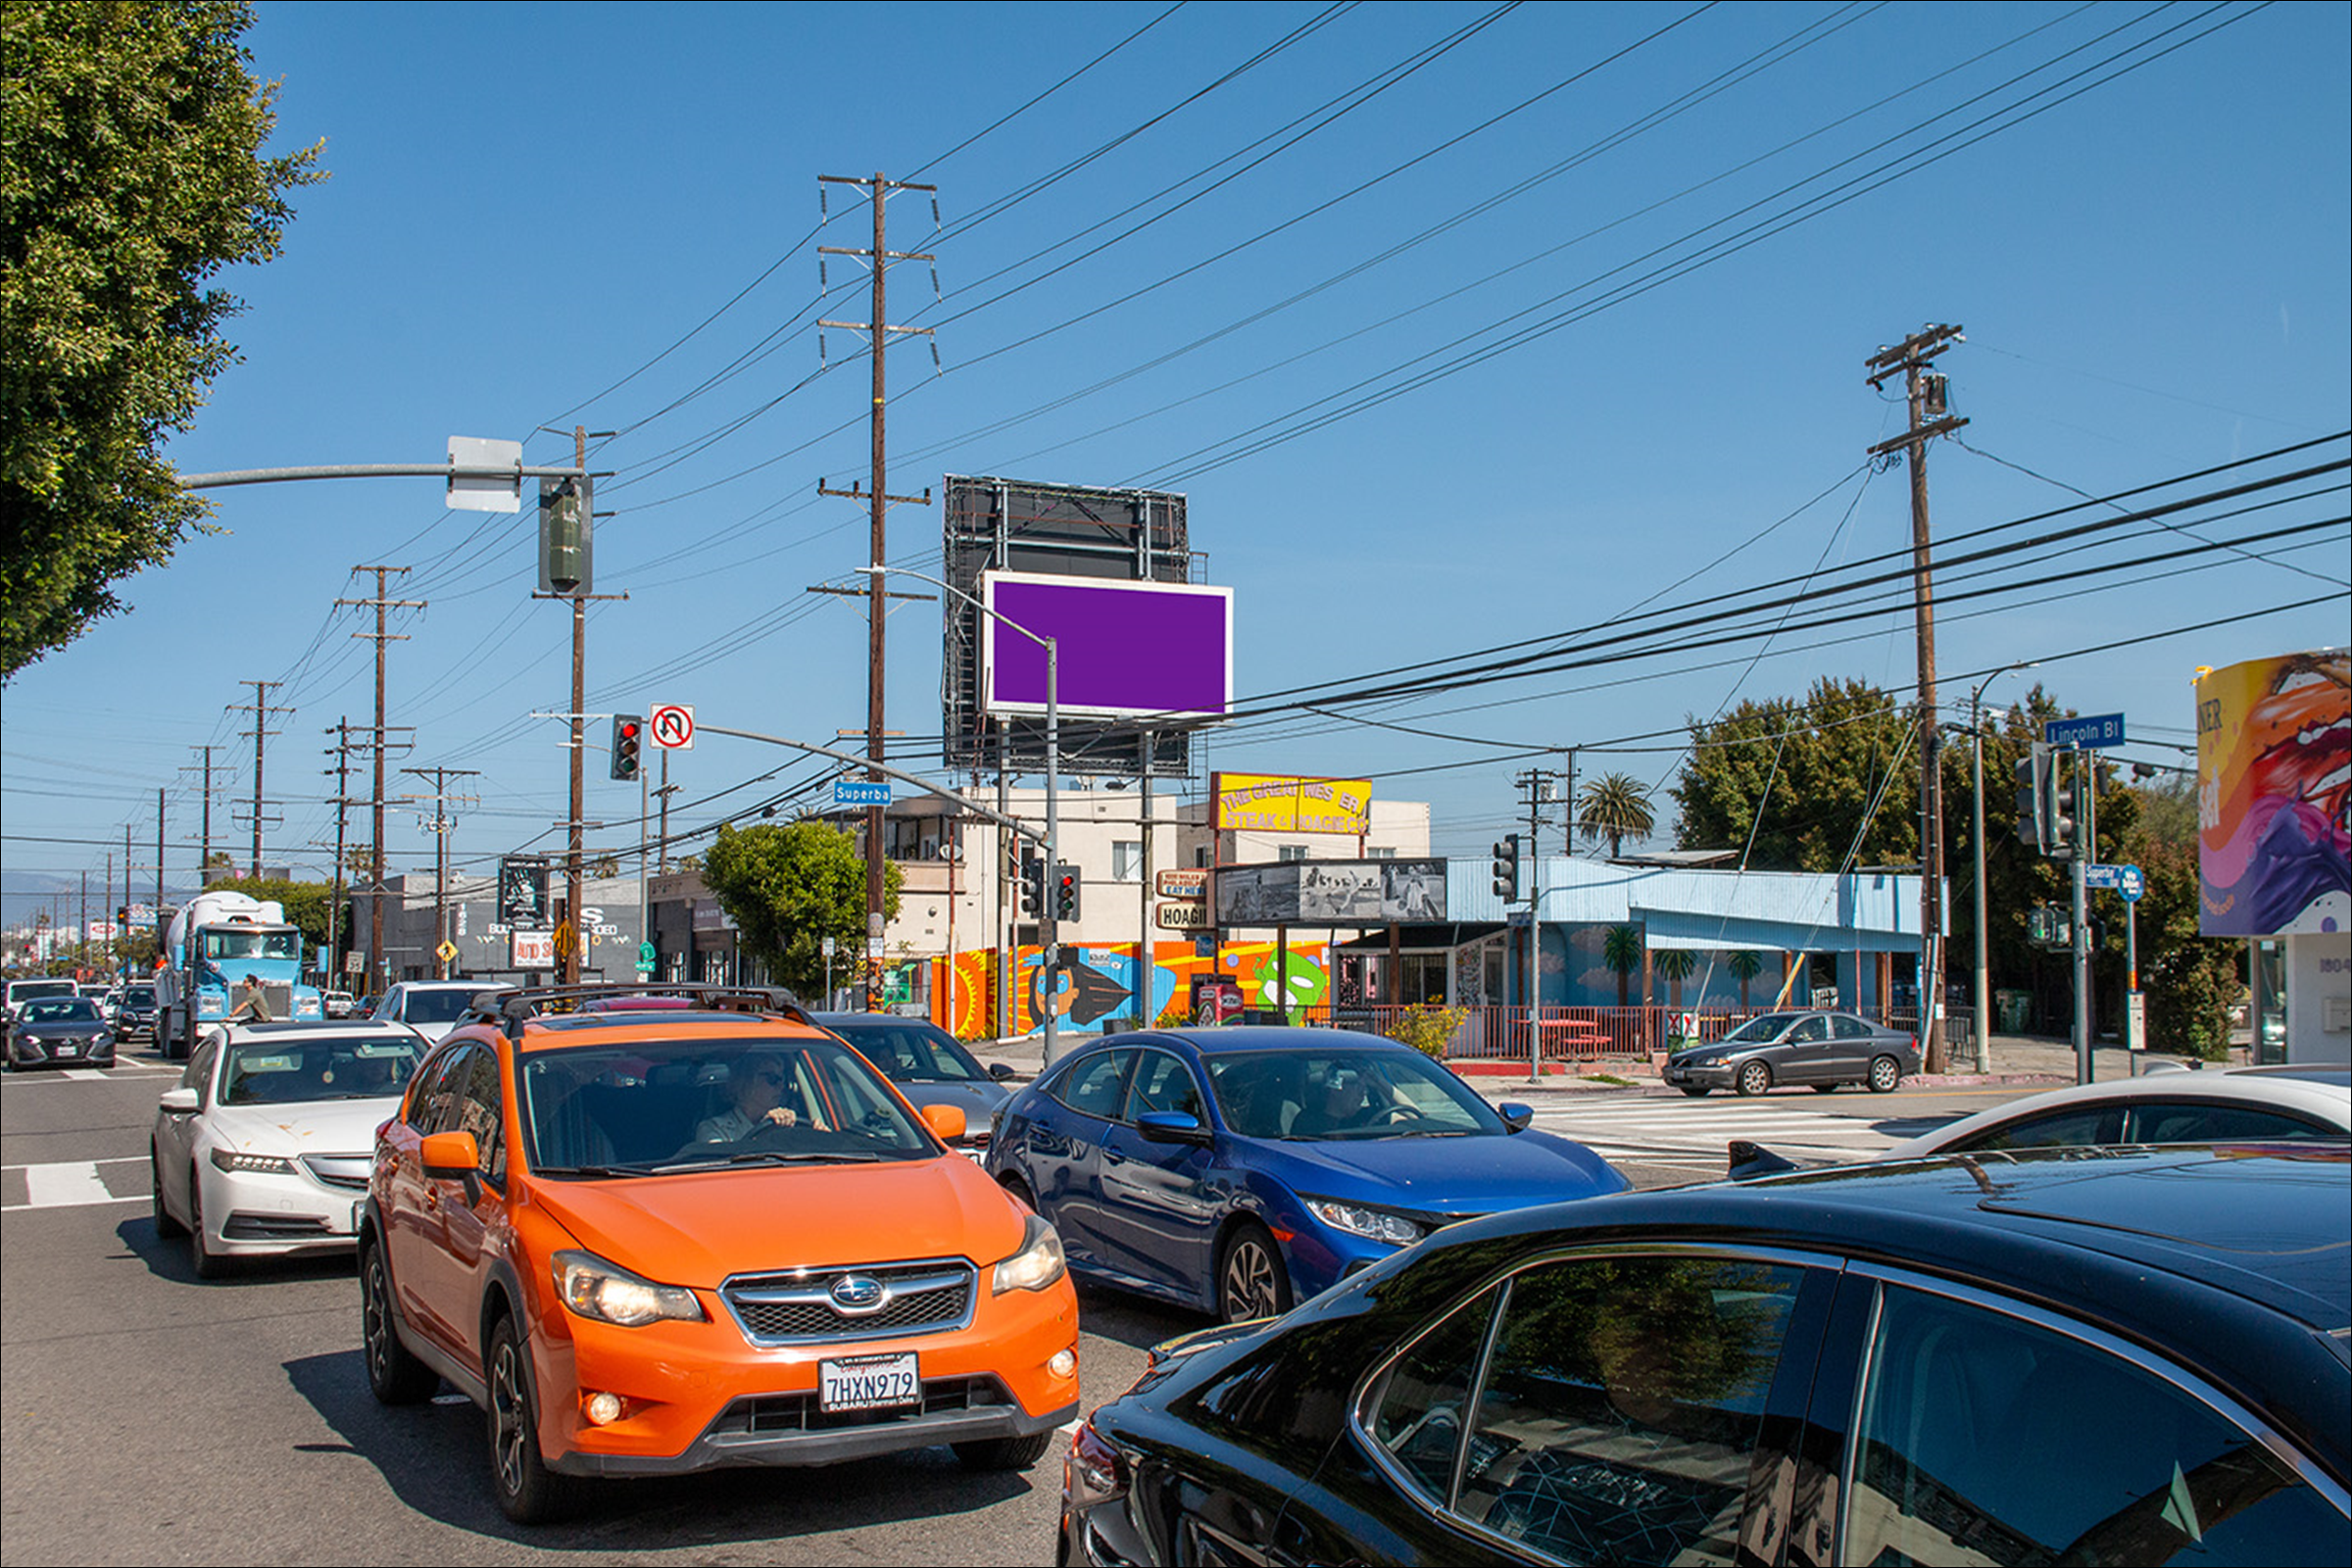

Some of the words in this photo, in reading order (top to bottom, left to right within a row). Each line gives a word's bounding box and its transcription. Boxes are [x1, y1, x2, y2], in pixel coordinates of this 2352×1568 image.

[2050, 724, 2099, 744] Lincoln
[2104, 720, 2120, 738] Bl
[836, 786, 889, 801] Superba
[1221, 787, 1251, 811] THE
[1251, 780, 1299, 800] GREAT
[1225, 811, 1278, 829] STEAK
[1290, 814, 1346, 832] HOAGIE
[1166, 886, 1184, 895] EAT
[516, 941, 540, 959] AUTO
[827, 1372, 912, 1401] 7HXN979
[829, 1399, 868, 1411] SUBARU
